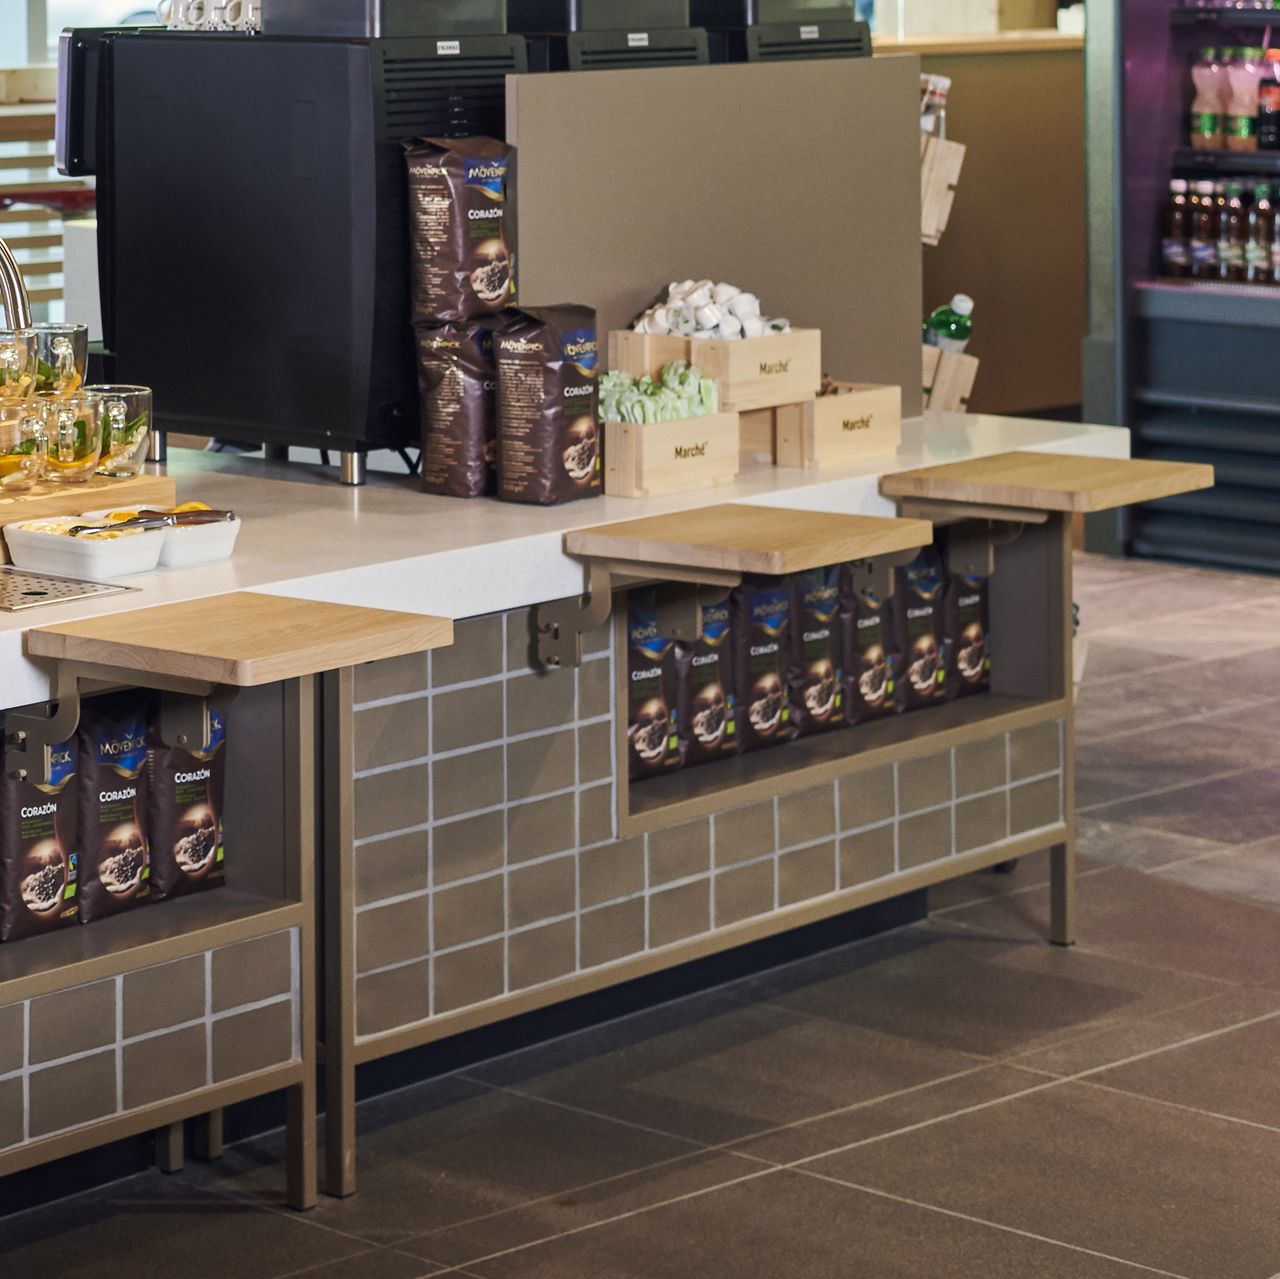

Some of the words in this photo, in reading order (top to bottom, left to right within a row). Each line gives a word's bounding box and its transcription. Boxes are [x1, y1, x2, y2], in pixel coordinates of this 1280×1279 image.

[469, 165, 507, 178] MÖVENP
[468, 208, 503, 220] CORAZÓN
[760, 359, 788, 375] Marché
[564, 385, 593, 398] CORAZÓN
[843, 416, 870, 432] Marché
[674, 442, 705, 459] Marché
[174, 768, 210, 784] CORAZÓN
[99, 787, 136, 802] CORAZÓN
[21, 802, 57, 818] CORAZÓN
